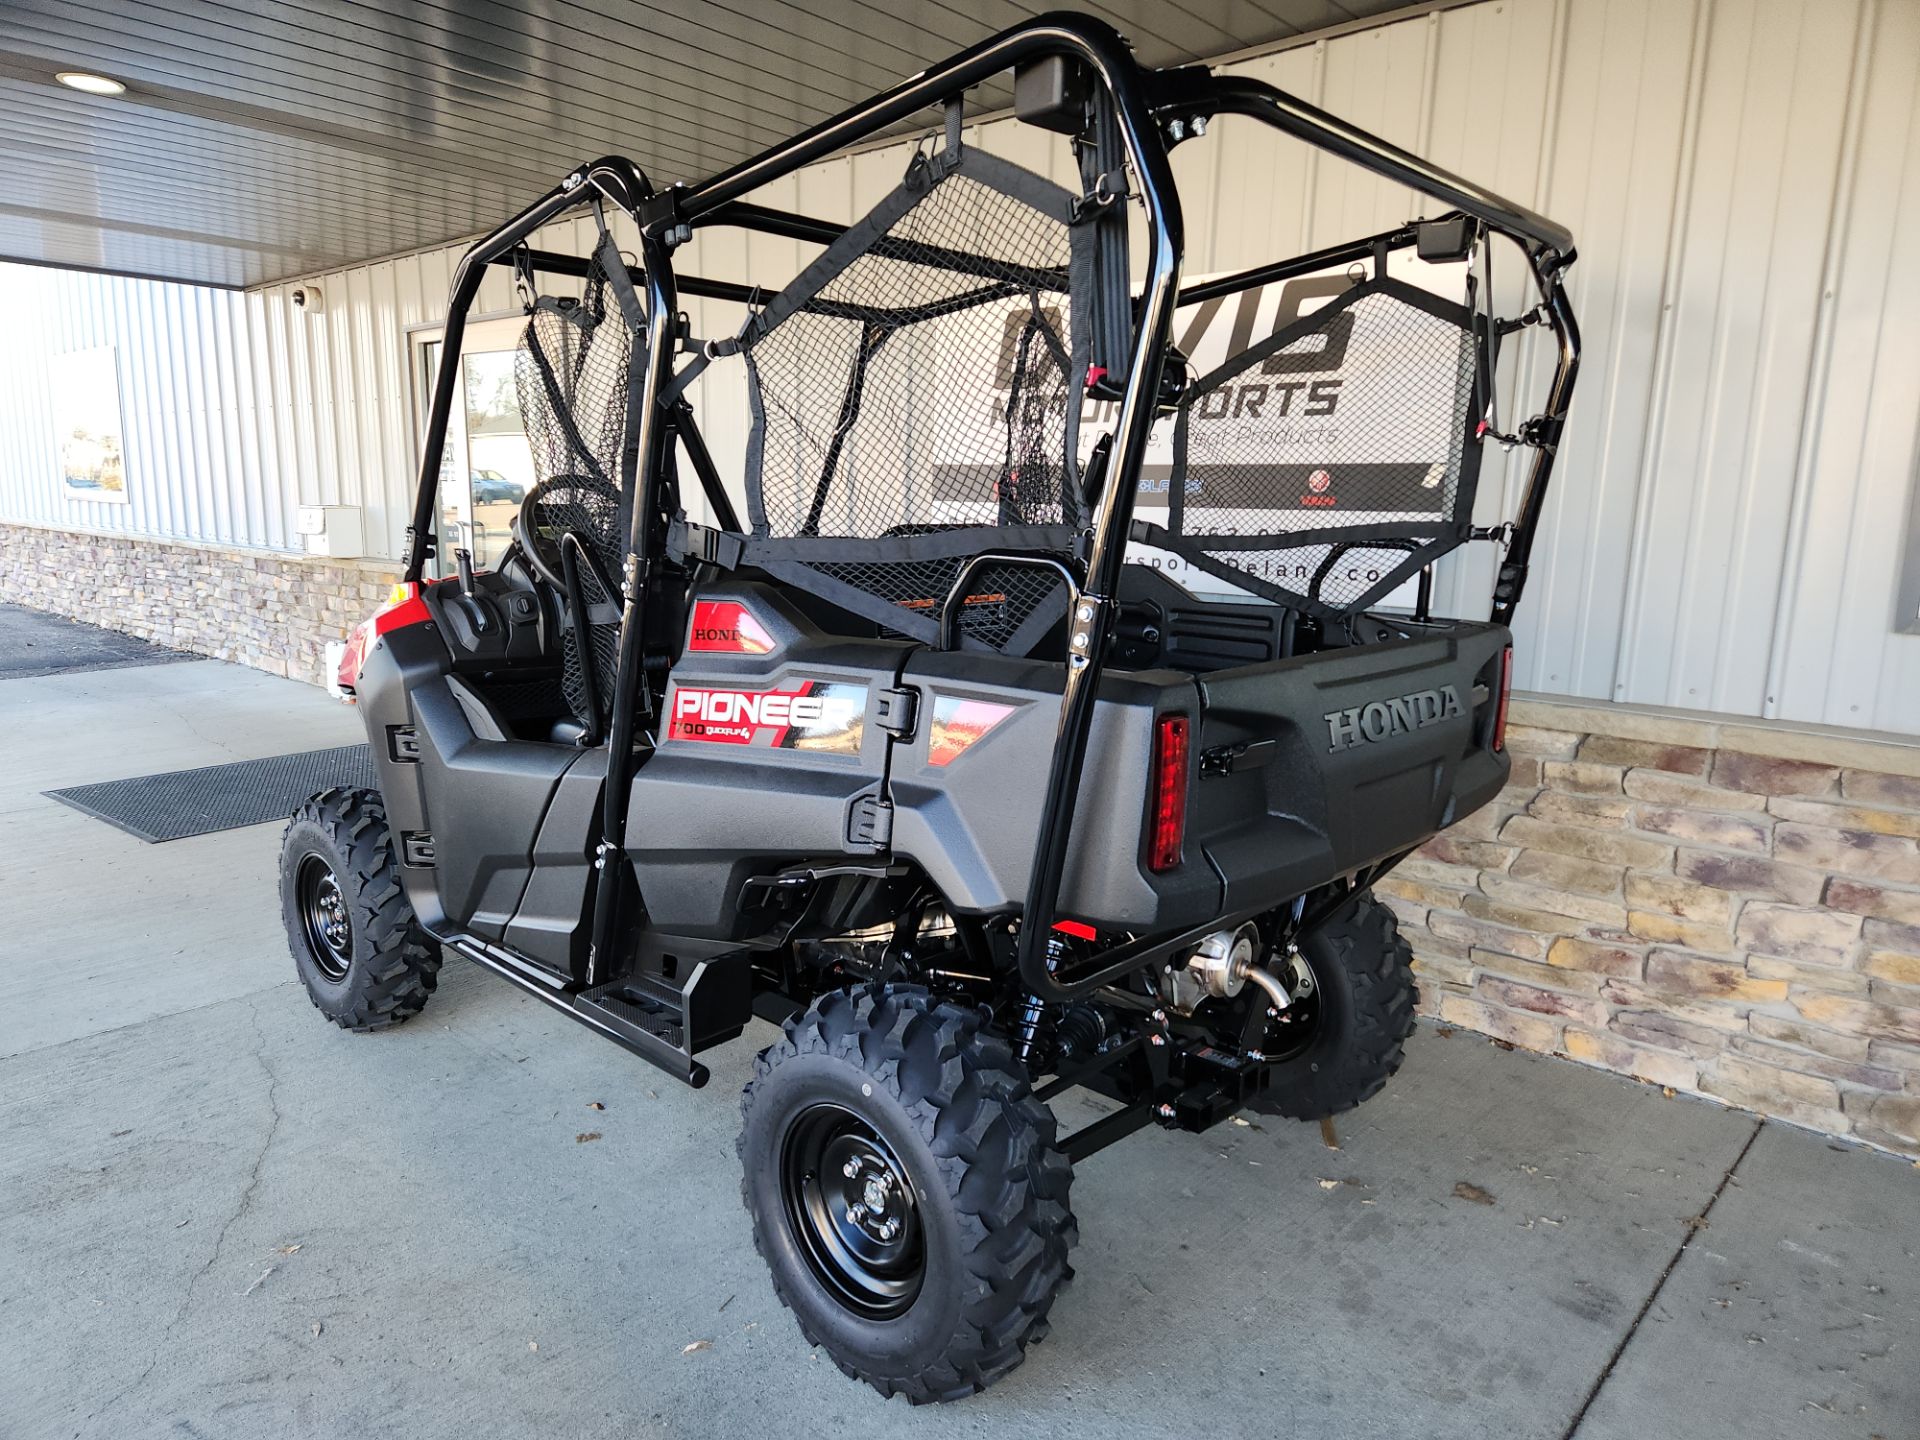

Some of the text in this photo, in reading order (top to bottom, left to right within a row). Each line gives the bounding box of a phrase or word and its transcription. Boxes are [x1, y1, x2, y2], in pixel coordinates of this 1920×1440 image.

[695, 629, 745, 641] HOND
[677, 690, 847, 728] PIONEE
[1324, 685, 1466, 754] HONDA
